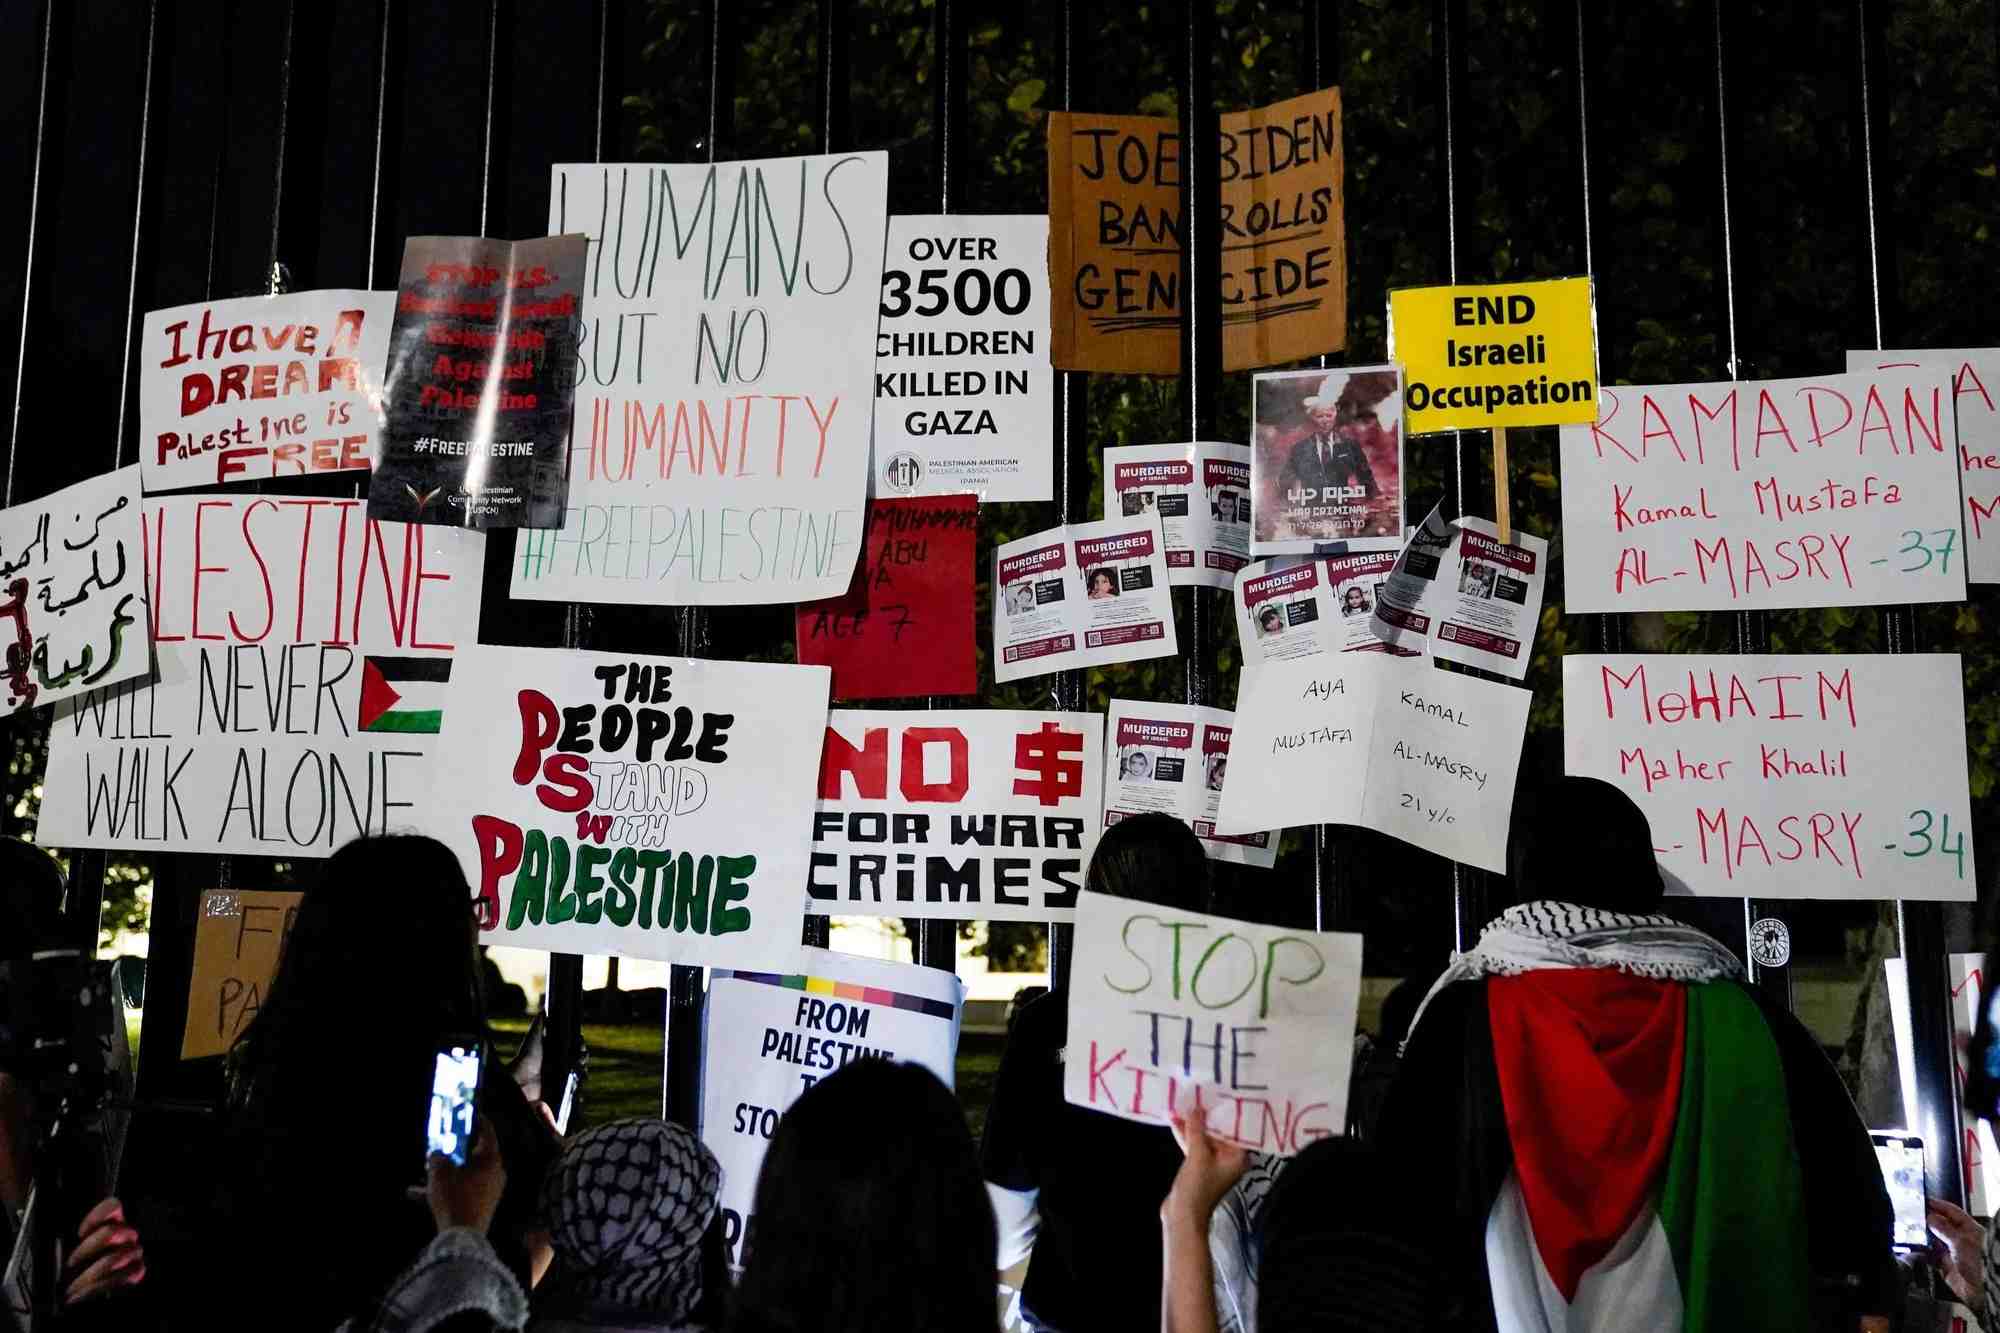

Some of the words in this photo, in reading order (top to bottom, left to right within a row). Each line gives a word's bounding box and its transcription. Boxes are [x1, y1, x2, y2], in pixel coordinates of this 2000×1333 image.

[1072, 129, 1182, 187] JOE
[1220, 110, 1335, 182] BIDEN
[560, 157, 867, 299] HUMANS
[1100, 187, 1333, 245] BANROLLS
[909, 237, 998, 261] OVER
[879, 268, 1031, 318] 3500
[1075, 248, 1332, 313] GENCIDE
[1453, 295, 1536, 326] END
[160, 321, 192, 368] I
[198, 310, 321, 359] have
[695, 309, 768, 385] NO
[876, 330, 1034, 357] CHILDREN
[1447, 335, 1545, 367] Israeli
[181, 356, 368, 417] DREAM
[420, 384, 537, 410] Paleine
[876, 371, 986, 398] KILLED
[995, 370, 1028, 395] IN
[1406, 375, 1592, 414] Occupation
[328, 401, 352, 426] is
[905, 410, 998, 436] GAZA
[1592, 384, 1944, 471] RAMADAN
[217, 433, 371, 484] FREE
[413, 437, 534, 457] #FREEPESTINE
[573, 395, 839, 482] HUMANITY
[1120, 465, 1187, 478] MURDERED
[1208, 463, 1250, 478] MURDER
[1313, 505, 1369, 517] CRIMINAL
[1614, 484, 1718, 532] Kamal
[519, 504, 858, 583] #FREEPALESTINE
[1003, 549, 1061, 572] MURDERED
[1081, 535, 1148, 554] MURDERED
[142, 499, 456, 650] LESTINE
[1248, 569, 1312, 593] MURDERED
[1616, 534, 1853, 599] AL-MASRY
[880, 604, 918, 642] 7
[73, 672, 172, 740] WILL
[198, 644, 354, 738] NEVER
[594, 662, 673, 704] THE
[1302, 678, 1345, 701] AYA
[1400, 690, 1471, 727] KAMAL
[512, 688, 735, 786] PEOPLE
[1122, 722, 1189, 738] MURDERED
[1272, 727, 1353, 754] MUSTAFA
[535, 753, 709, 815] STAND
[817, 726, 969, 803] NO
[1013, 721, 1084, 807] $
[1619, 746, 1734, 793] Maher
[1761, 744, 1848, 778] Khalil
[86, 744, 194, 841] WALK
[217, 748, 424, 847] ALONE
[1400, 793, 1421, 811] 21
[576, 810, 669, 847] WITH
[812, 811, 930, 844] FOR
[950, 814, 1085, 850] WAR
[472, 814, 758, 937] PALESTINE
[1104, 914, 1325, 1019] STOP
[795, 996, 871, 1038] FROM
[1131, 1010, 1268, 1090] THE
[734, 1102, 782, 1140] STO
